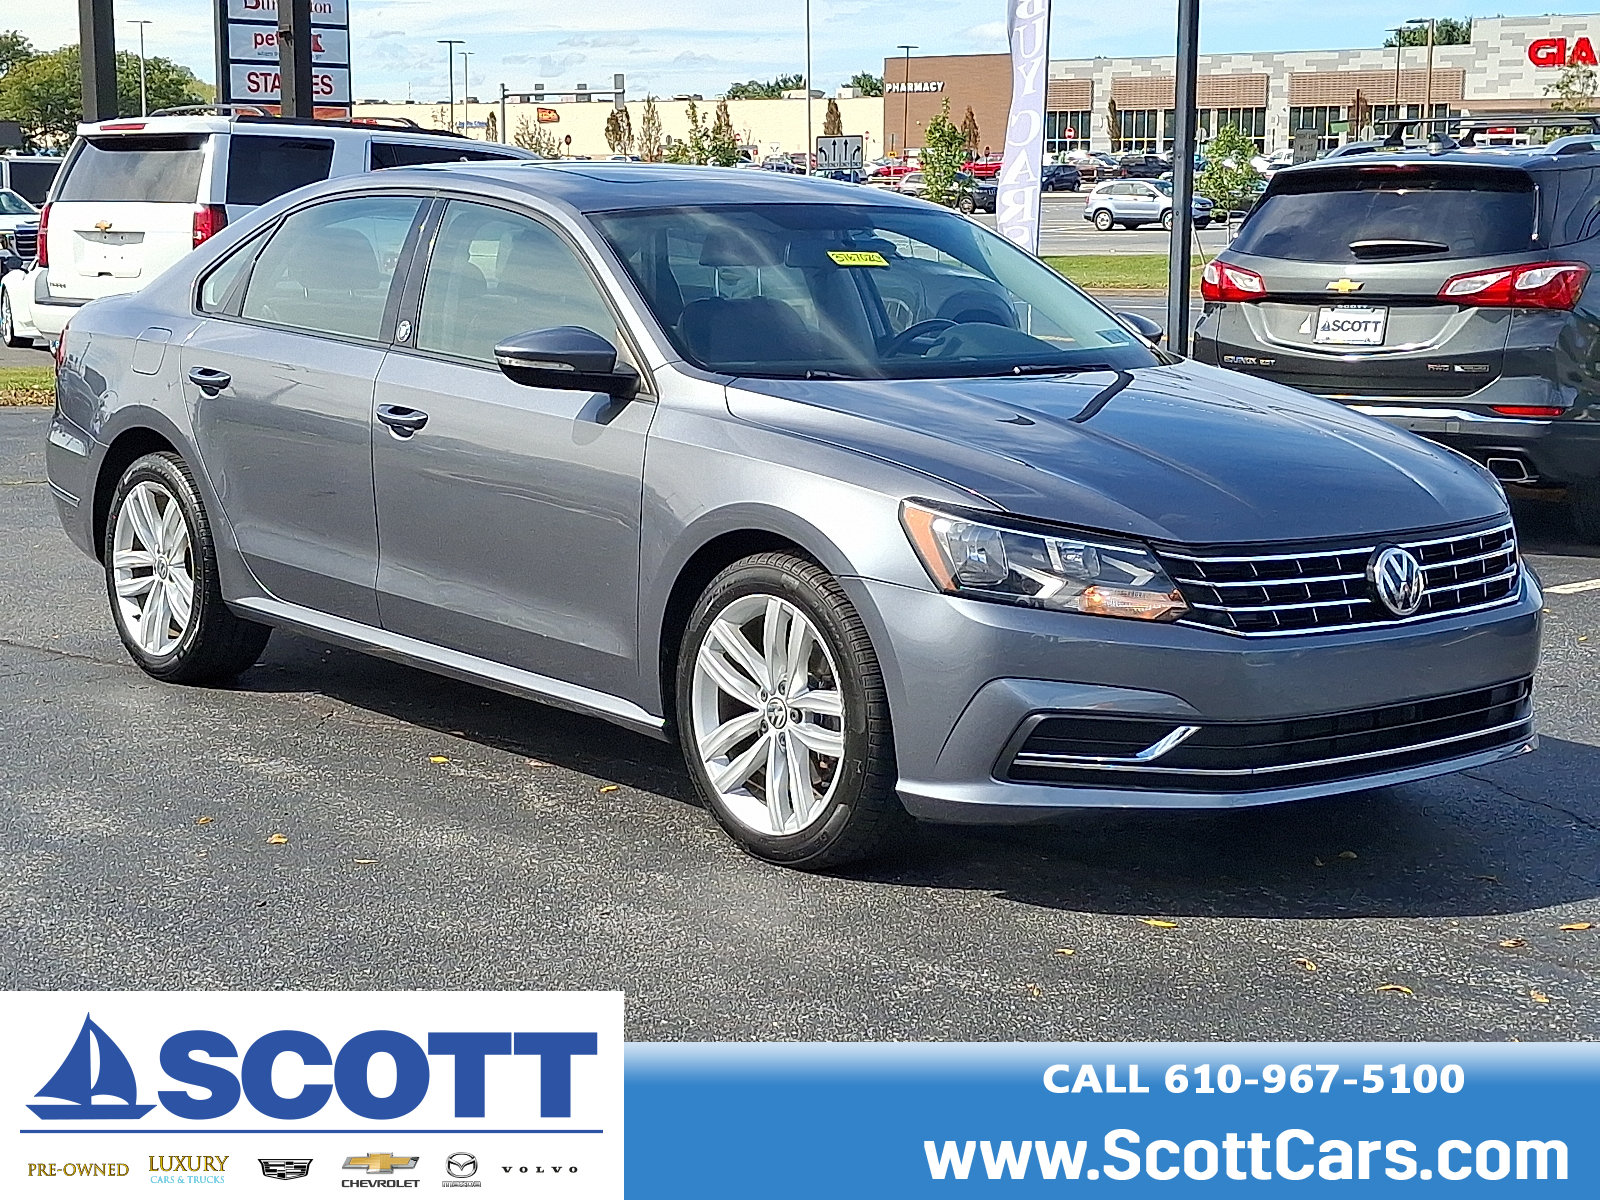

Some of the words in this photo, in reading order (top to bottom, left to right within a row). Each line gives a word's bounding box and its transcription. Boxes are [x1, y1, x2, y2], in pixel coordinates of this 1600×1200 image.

[247, 72, 333, 95] STAES
[885, 82, 944, 93] PHARMACY
[1331, 320, 1381, 332] SCOTT
